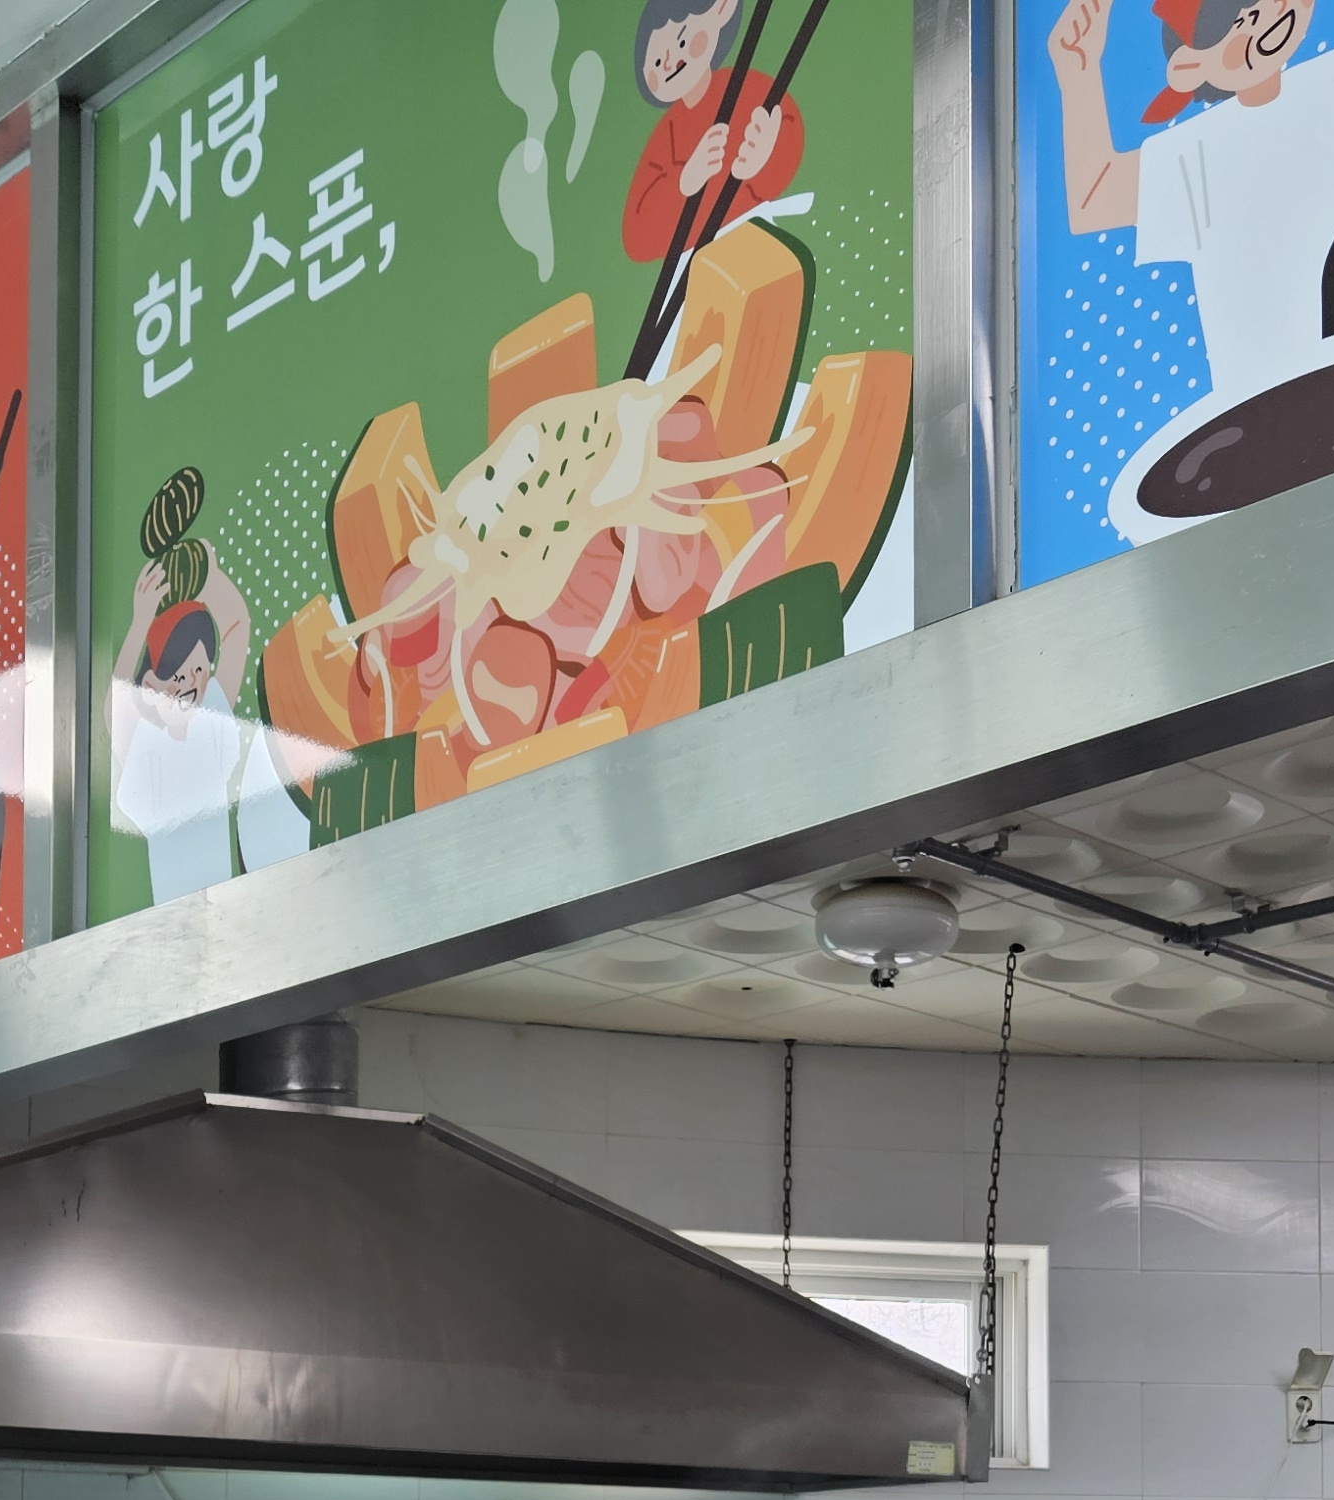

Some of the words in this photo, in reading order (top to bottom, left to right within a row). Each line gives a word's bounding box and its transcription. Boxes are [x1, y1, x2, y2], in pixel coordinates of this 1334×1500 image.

[132, 55, 279, 230] 사랑
[132, 258, 204, 400] 한
[226, 147, 397, 333] 스푼,
